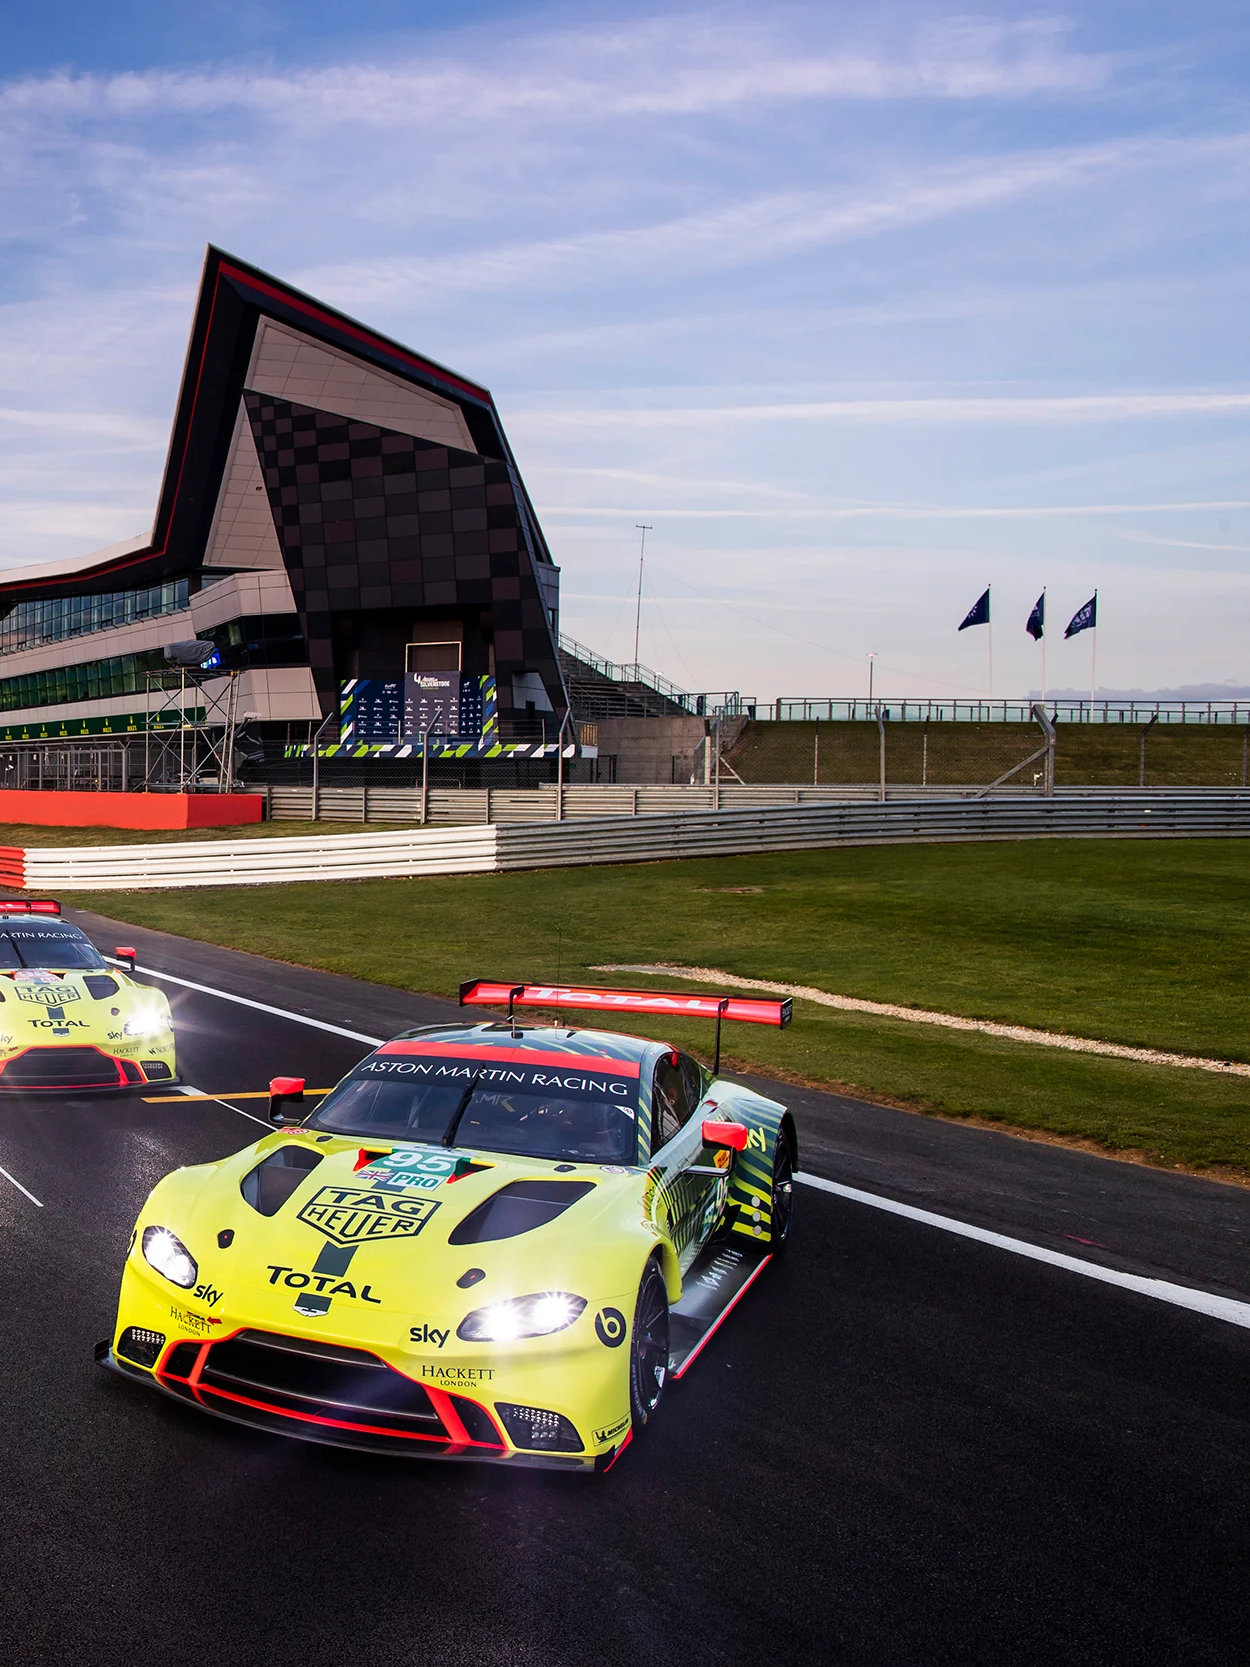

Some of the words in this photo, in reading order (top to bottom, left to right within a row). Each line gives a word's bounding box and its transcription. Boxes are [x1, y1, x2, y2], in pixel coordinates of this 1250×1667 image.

[38, 932, 83, 940] RACING
[22, 993, 76, 1004] HEUER
[528, 986, 717, 1011] TOTAL
[27, 1019, 90, 1028] TOTAL
[107, 1031, 123, 1040] sky
[113, 1046, 140, 1055] HACKETT
[360, 1061, 433, 1076] ASTON
[436, 1065, 526, 1083] MARTIN
[531, 1073, 629, 1096] RACING
[383, 1151, 452, 1172] 95
[393, 1174, 439, 1188] PRO
[329, 1190, 425, 1215] TAG
[307, 1207, 413, 1238] HEUER
[266, 1264, 382, 1304] TOTAL
[193, 1284, 224, 1307] sky
[170, 1306, 212, 1334] HACKETT
[178, 1324, 201, 1337] LONDON
[410, 1323, 451, 1348] sky
[422, 1365, 495, 1380] HACKETT
[440, 1380, 477, 1388] LONDON
[606, 1417, 630, 1437] MICHELIN
